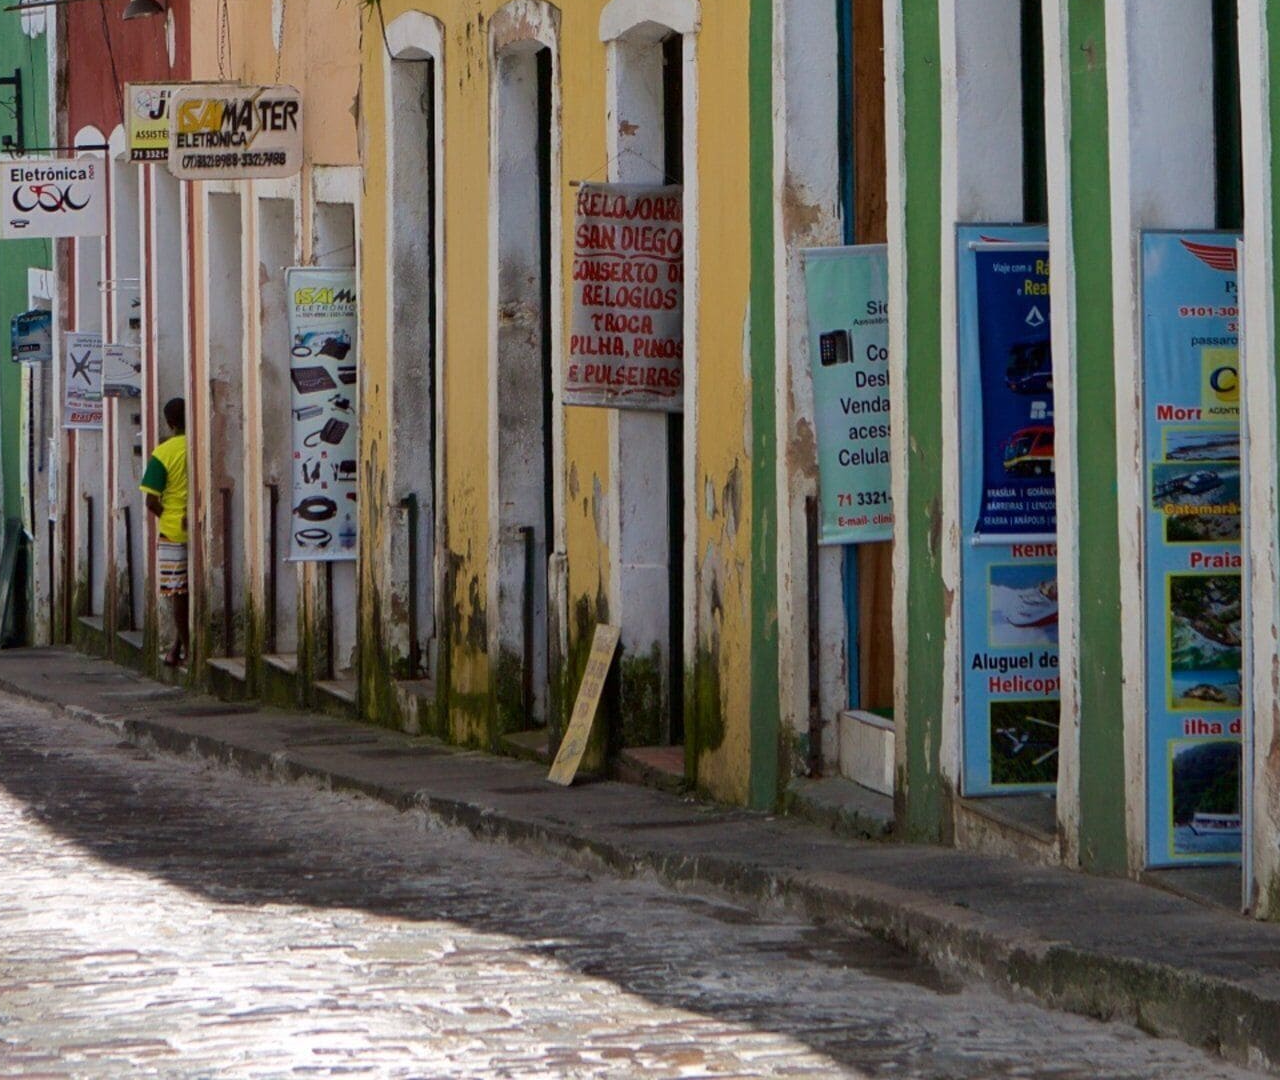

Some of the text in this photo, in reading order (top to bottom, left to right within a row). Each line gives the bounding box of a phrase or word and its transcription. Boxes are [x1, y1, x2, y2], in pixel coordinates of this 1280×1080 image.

[10, 166, 87, 182] Eletrônica
[576, 223, 683, 255] SAN DIEGO
[582, 284, 677, 310] RELOGIOS
[591, 313, 653, 334] TROCA
[584, 364, 681, 387] PULSEIRAS
[837, 494, 852, 507] 71
[971, 651, 1034, 674] Aluguel
